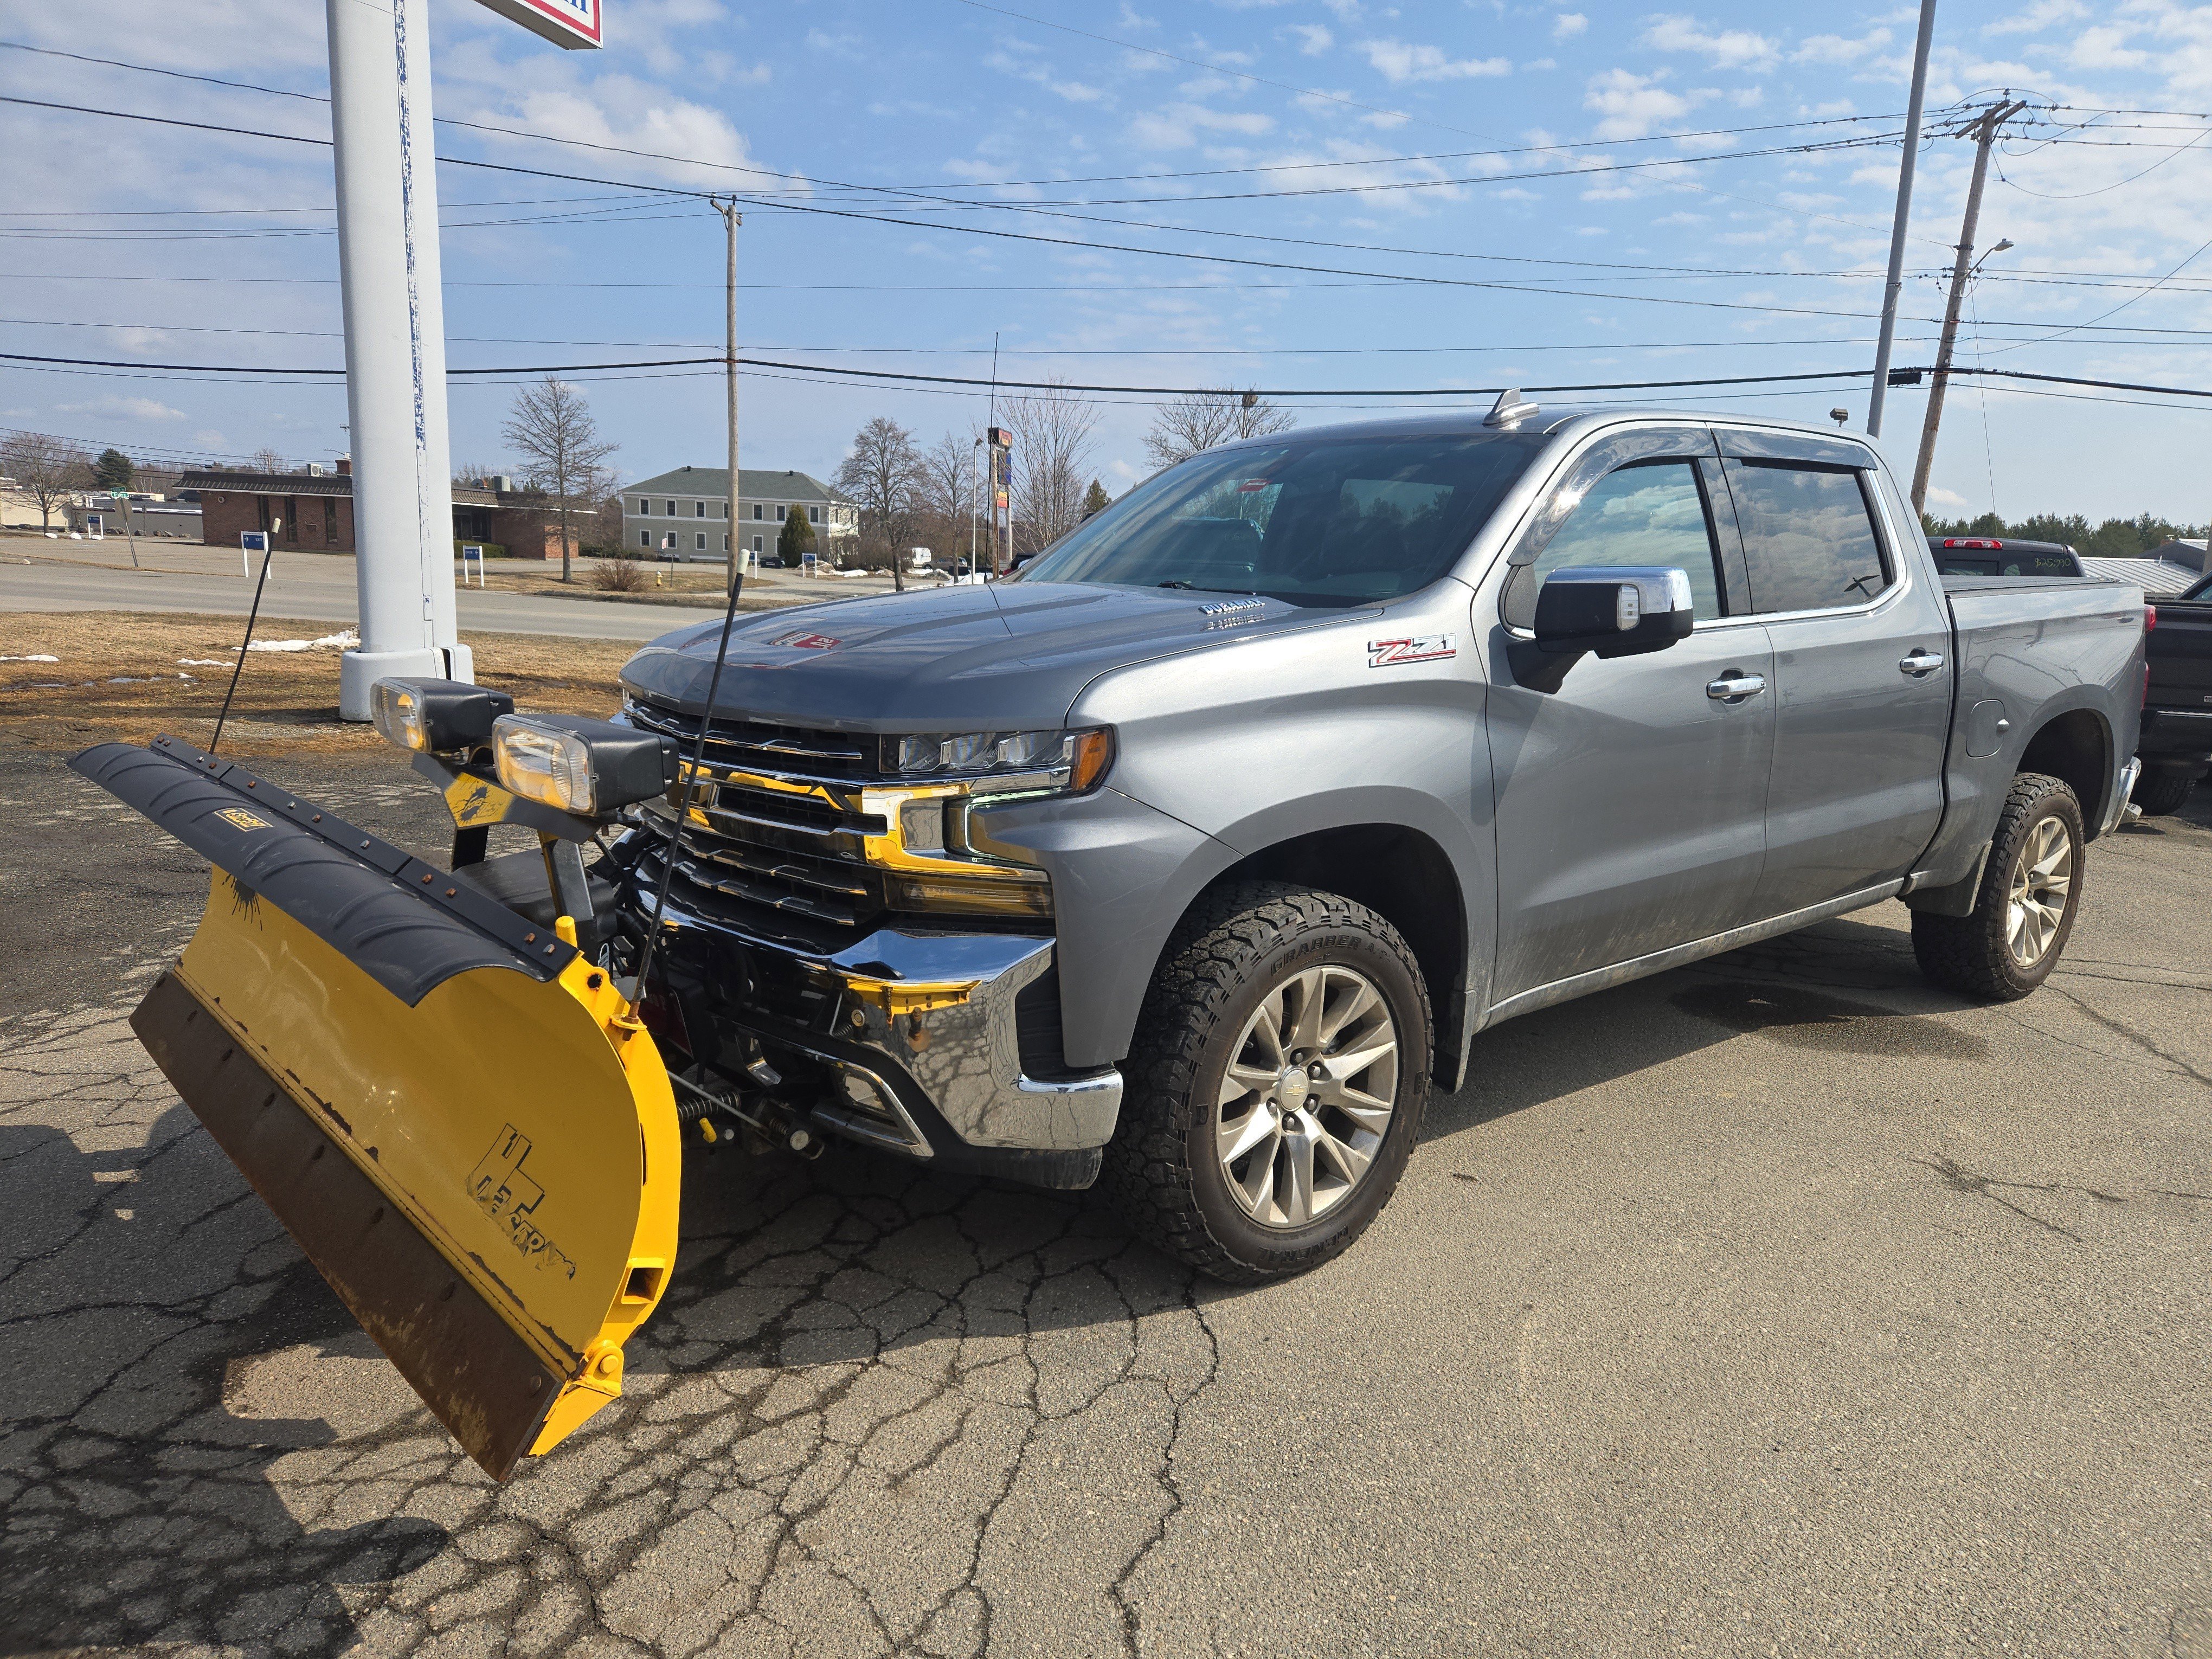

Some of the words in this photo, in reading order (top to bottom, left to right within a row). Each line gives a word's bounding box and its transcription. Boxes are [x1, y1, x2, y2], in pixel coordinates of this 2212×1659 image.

[1198, 598, 1265, 615] DURAMAX
[1367, 633, 1457, 668] Z71
[1270, 934, 1362, 976] GRABBER
[1258, 1225, 1348, 1263] GENERAL
